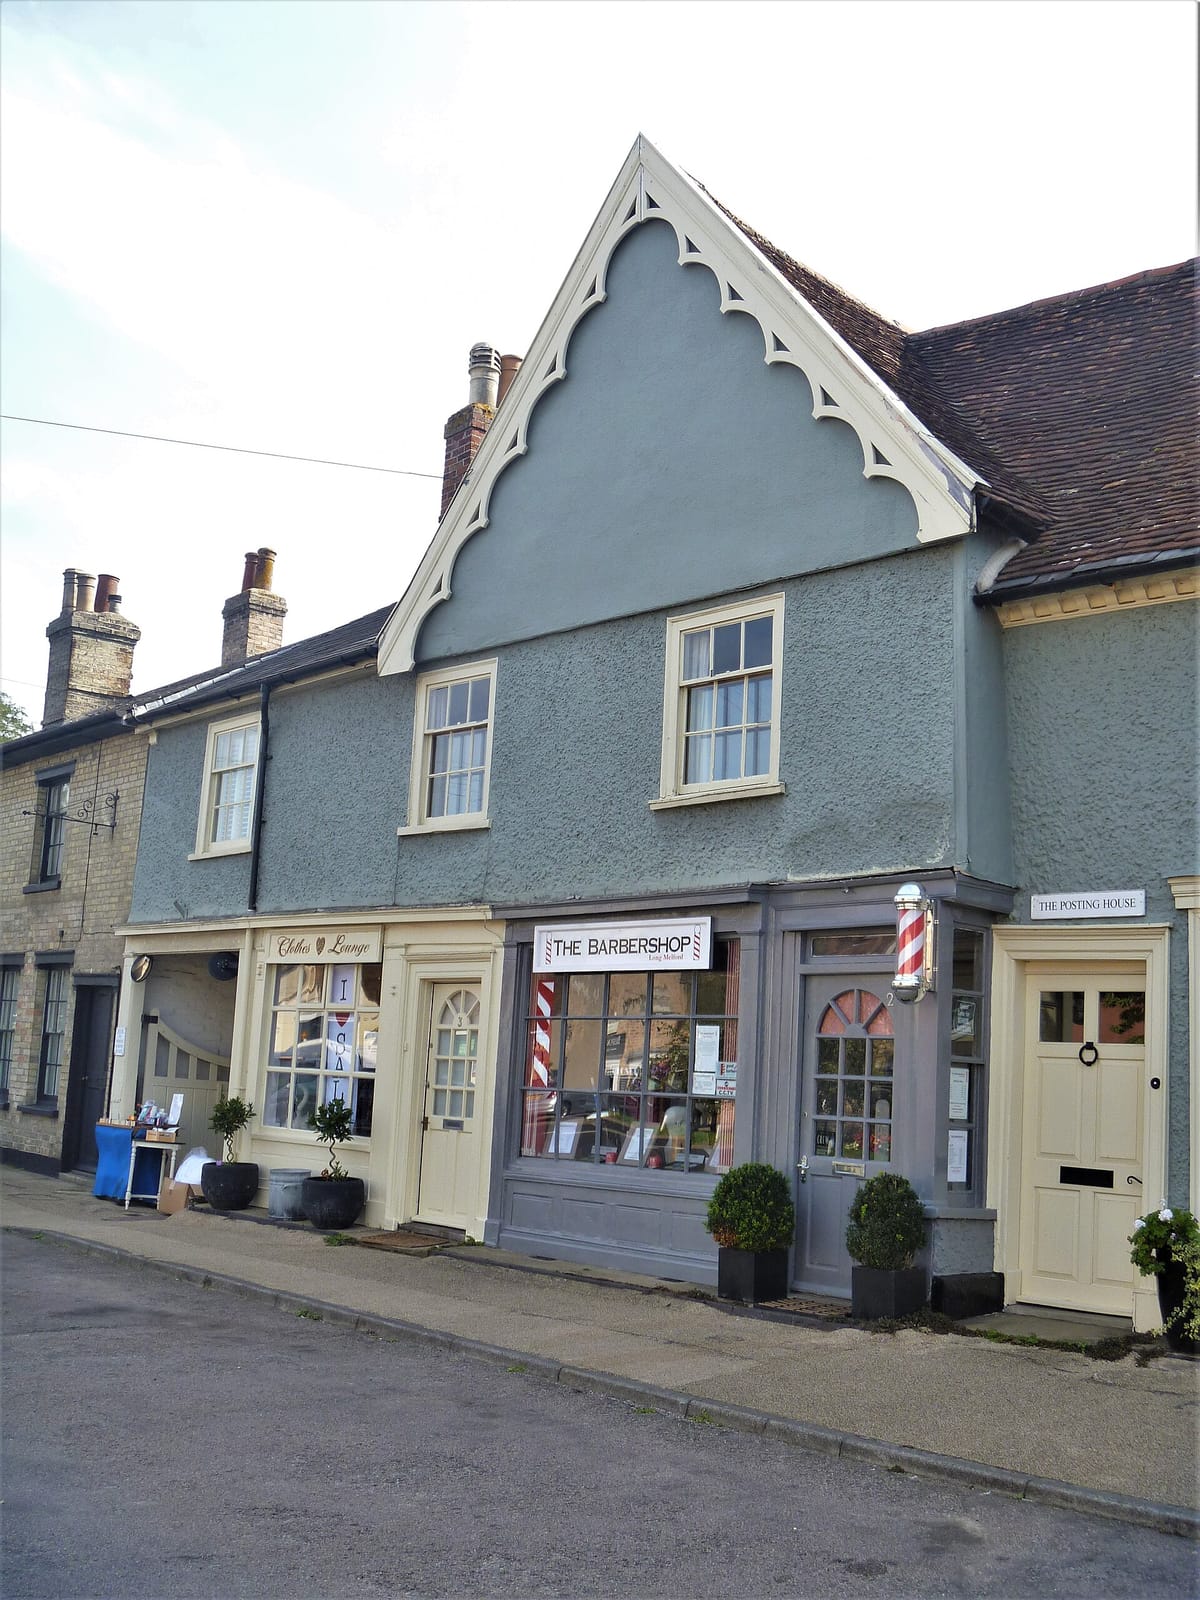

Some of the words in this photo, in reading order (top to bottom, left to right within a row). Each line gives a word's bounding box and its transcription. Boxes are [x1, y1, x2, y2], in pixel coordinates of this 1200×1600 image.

[1039, 901, 1057, 911] THE
[1060, 899, 1100, 911] POSTING
[1103, 898, 1136, 909] HOUSE
[277, 936, 311, 957] Clothes
[327, 934, 370, 957] Lounge
[554, 940, 581, 956] THE
[588, 936, 691, 955] BARBERSHOP
[887, 992, 894, 1007] 2
